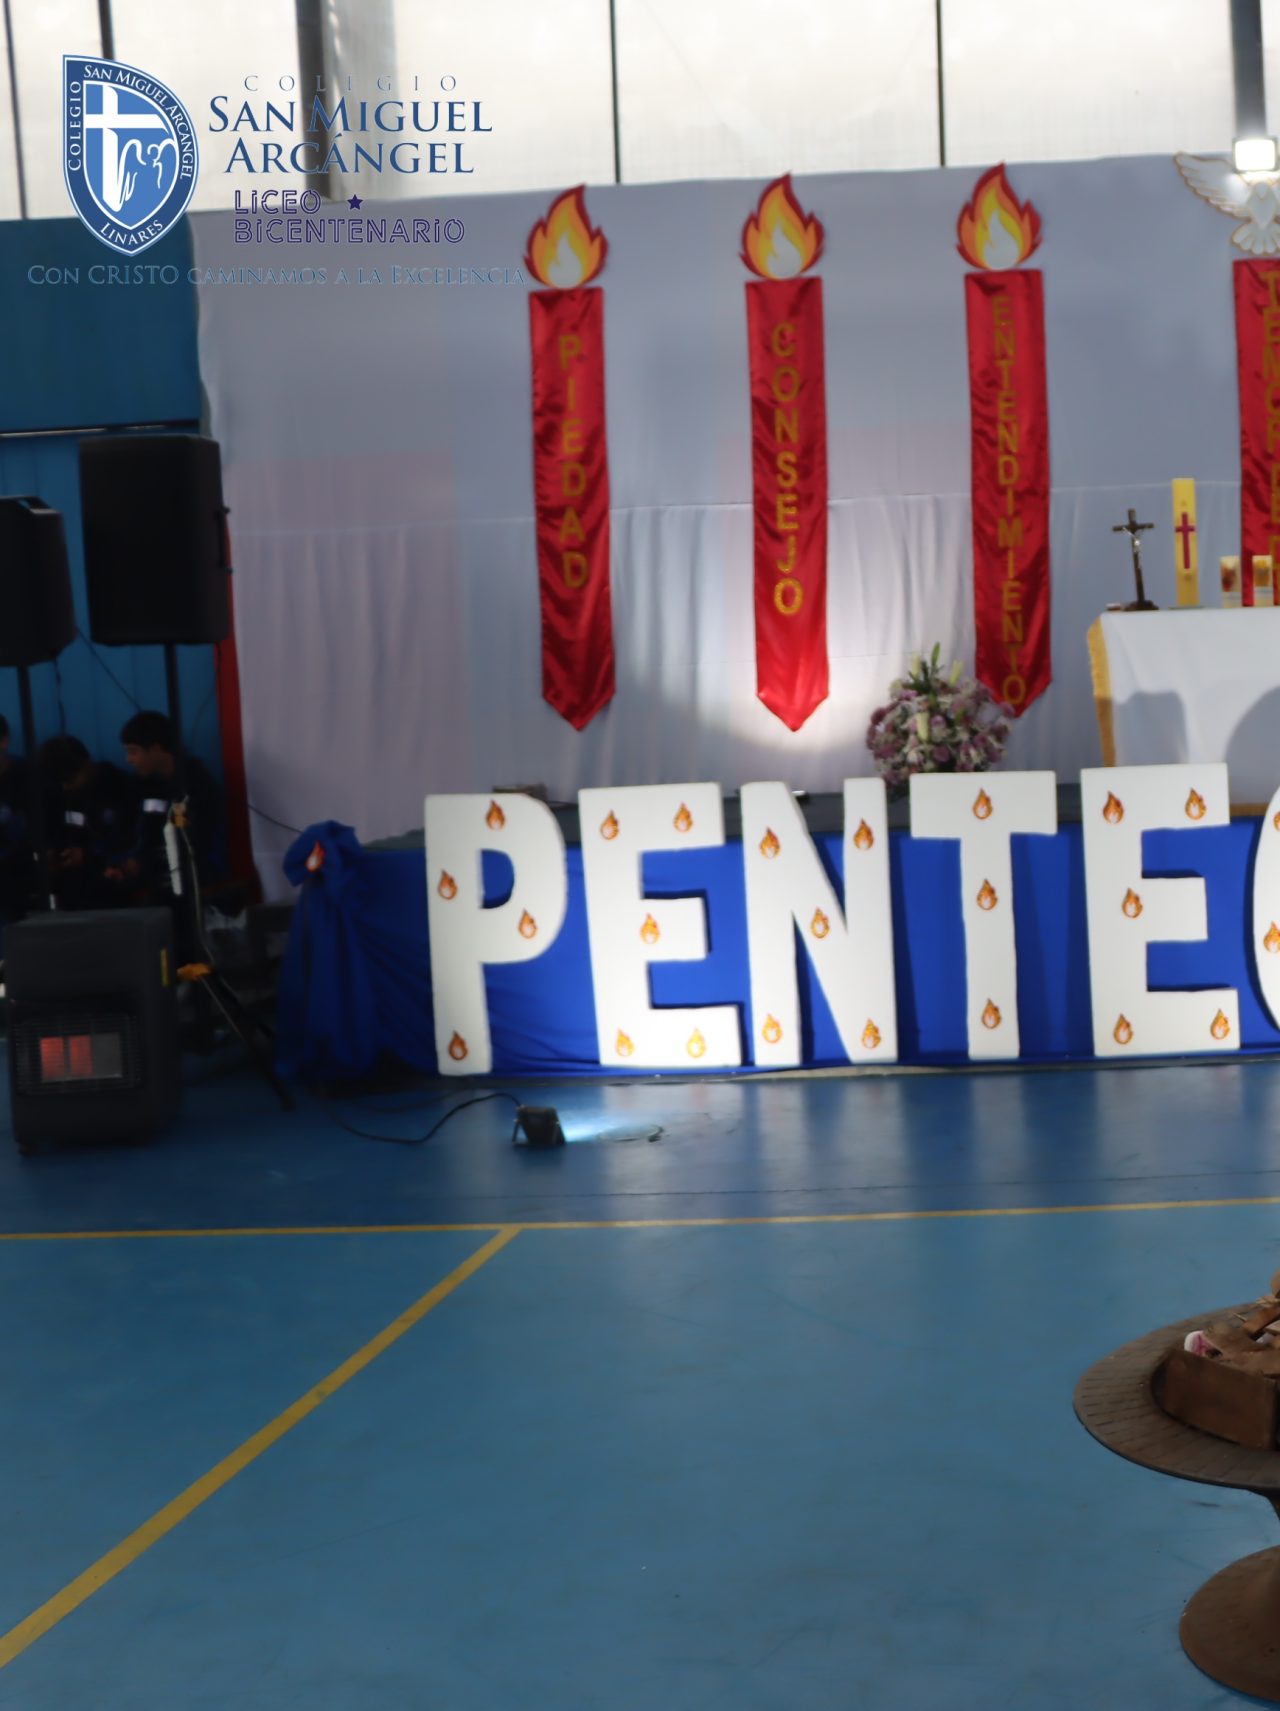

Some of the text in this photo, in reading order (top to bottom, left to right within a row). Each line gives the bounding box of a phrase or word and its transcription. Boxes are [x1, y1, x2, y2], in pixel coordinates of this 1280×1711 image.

[558, 334, 589, 589] PIEDAD
[771, 323, 804, 616] CONSEJO
[992, 296, 1027, 704] ENTENDIMIENTO
